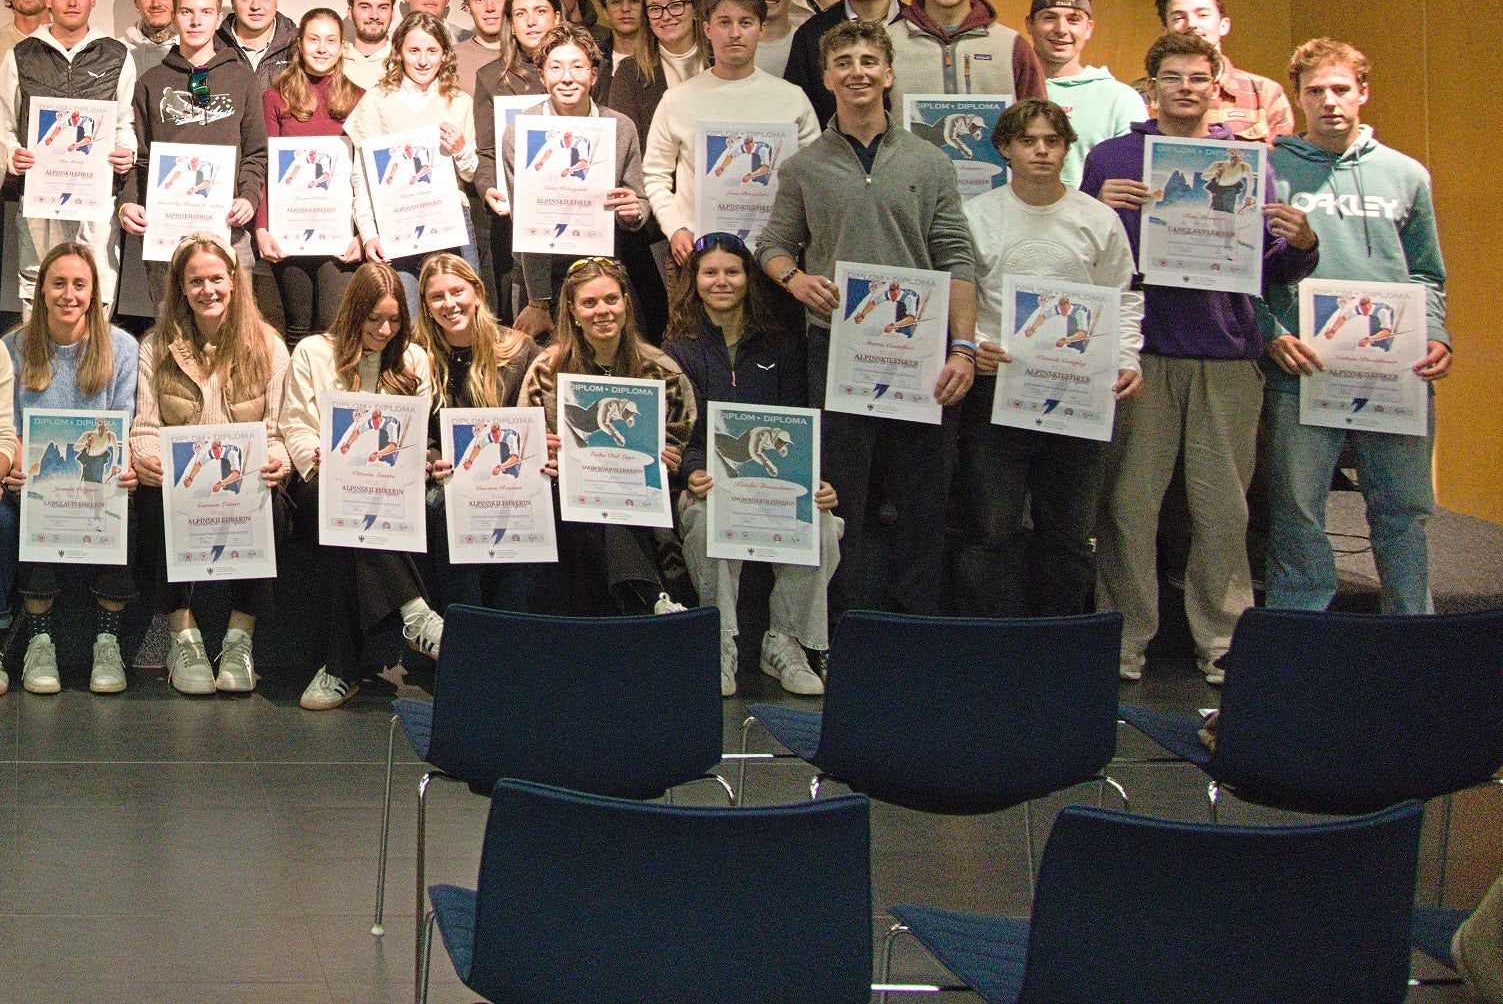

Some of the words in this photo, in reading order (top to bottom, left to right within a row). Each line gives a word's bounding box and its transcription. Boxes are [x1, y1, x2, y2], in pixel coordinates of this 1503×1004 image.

[1291, 192, 1399, 219] OAKLEY
[570, 383, 604, 392] DIPLOM
[611, 387, 653, 396] DIPLOMA
[332, 400, 368, 409] DIPLOM
[374, 404, 416, 413] DIPLOMA
[34, 417, 69, 426] DIPLOM
[76, 419, 118, 427] DIPLOMA
[492, 417, 533, 425] DIPLOMA
[721, 412, 756, 421] DIPLOM
[763, 415, 808, 425] DIPLOMA
[171, 435, 206, 443] DIPLOM
[214, 432, 255, 440] DIPLOMA
